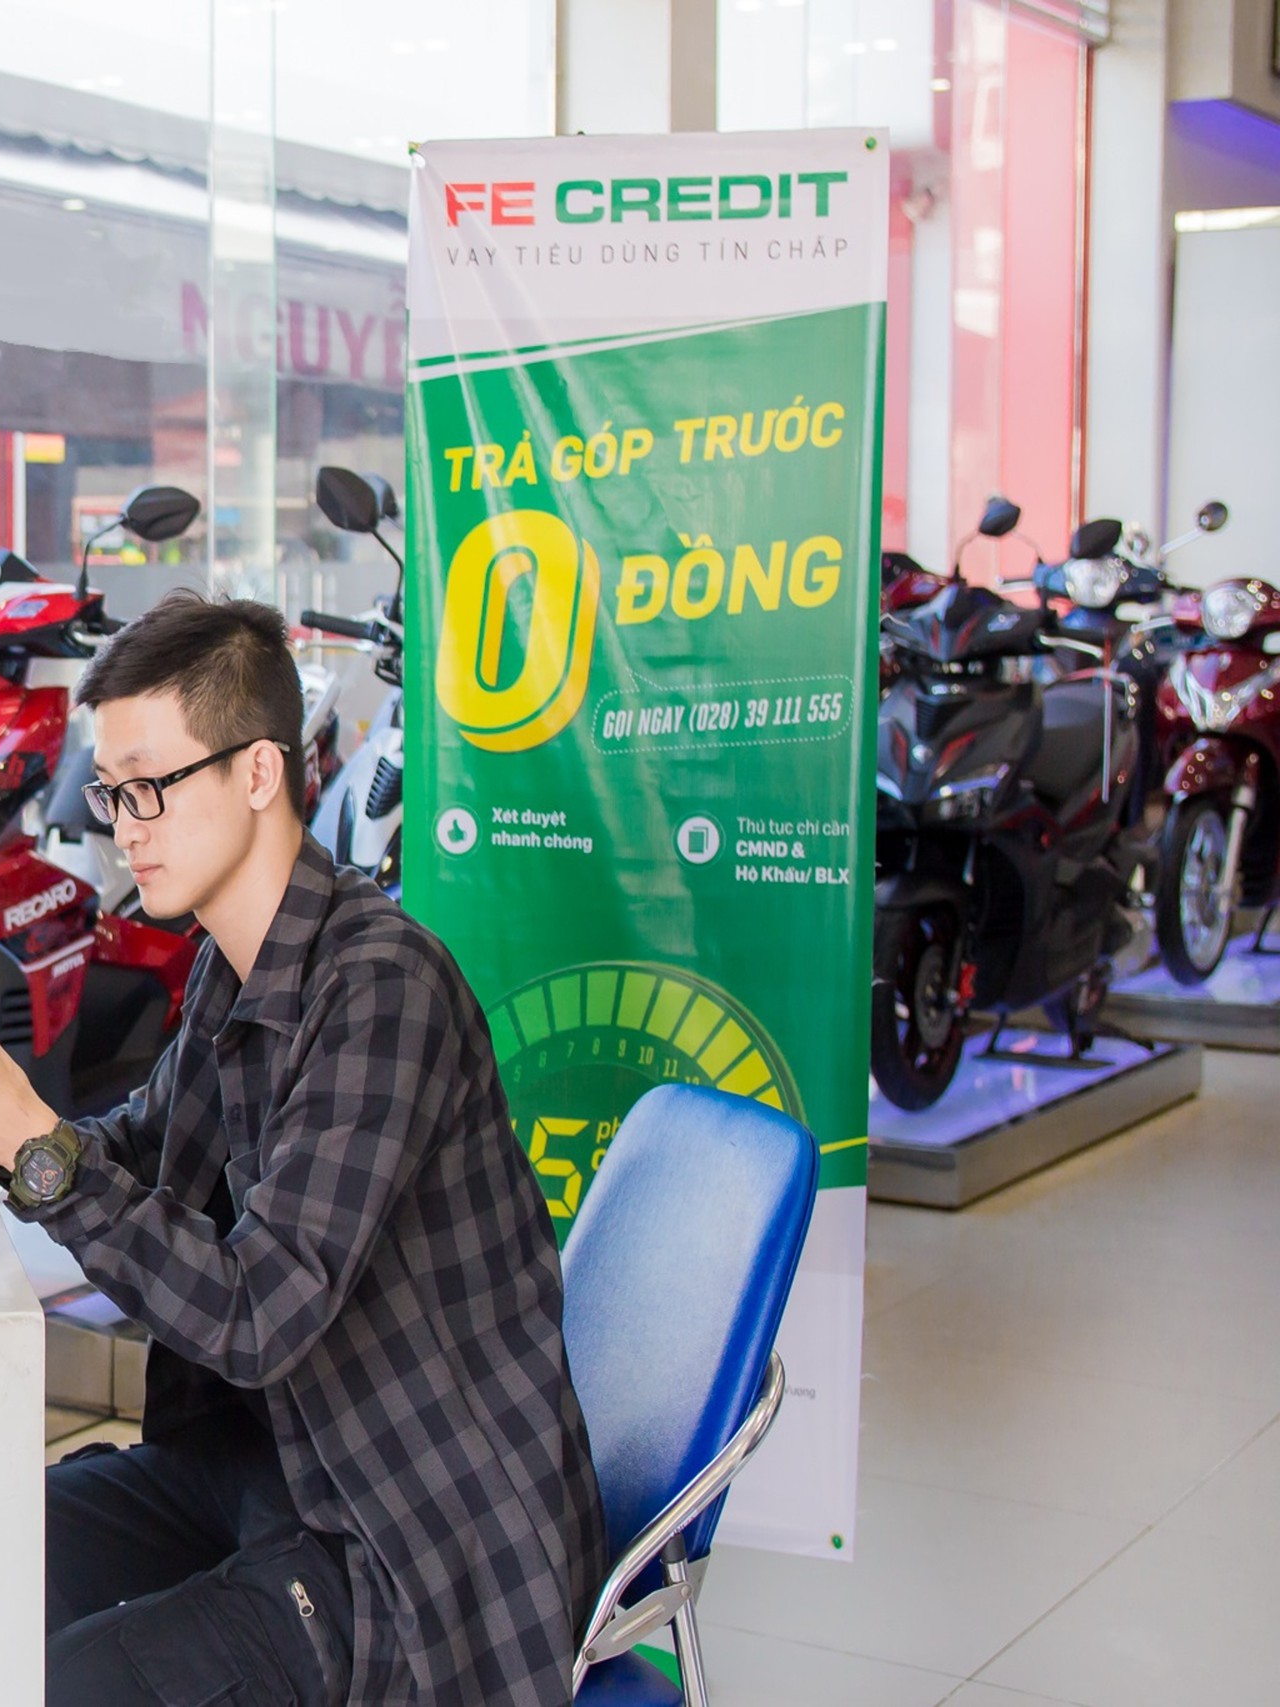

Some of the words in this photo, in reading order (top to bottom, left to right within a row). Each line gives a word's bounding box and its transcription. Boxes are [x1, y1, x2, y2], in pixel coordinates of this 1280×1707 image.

[445, 182, 536, 227] FE
[556, 172, 848, 224] CREDIT
[447, 247, 497, 266] VAY
[515, 243, 583, 265] TIÊU
[602, 240, 680, 263] DÙNG
[699, 238, 748, 261] TÍN
[768, 235, 848, 260] CHẤP
[444, 430, 538, 492] TRẢ
[550, 421, 654, 483] GÓP
[674, 395, 845, 464] TRƯỚC
[434, 509, 601, 753] 0
[615, 533, 843, 625] ĐỒNG
[603, 711, 633, 741] GỌI
[637, 705, 685, 735] NGAY
[689, 700, 739, 732] (028)
[744, 699, 769, 728] 39
[773, 697, 801, 725] 111
[807, 693, 843, 722] 555
[492, 807, 518, 824] Xét
[492, 831, 540, 847] nhanh
[544, 833, 593, 853] chóng
[736, 840, 788, 858] CMND
[791, 841, 805, 858] &
[815, 867, 850, 884] BLX
[4, 878, 77, 931] RECARO
[638, 1045, 654, 1065] 10
[663, 1058, 678, 1078] 11
